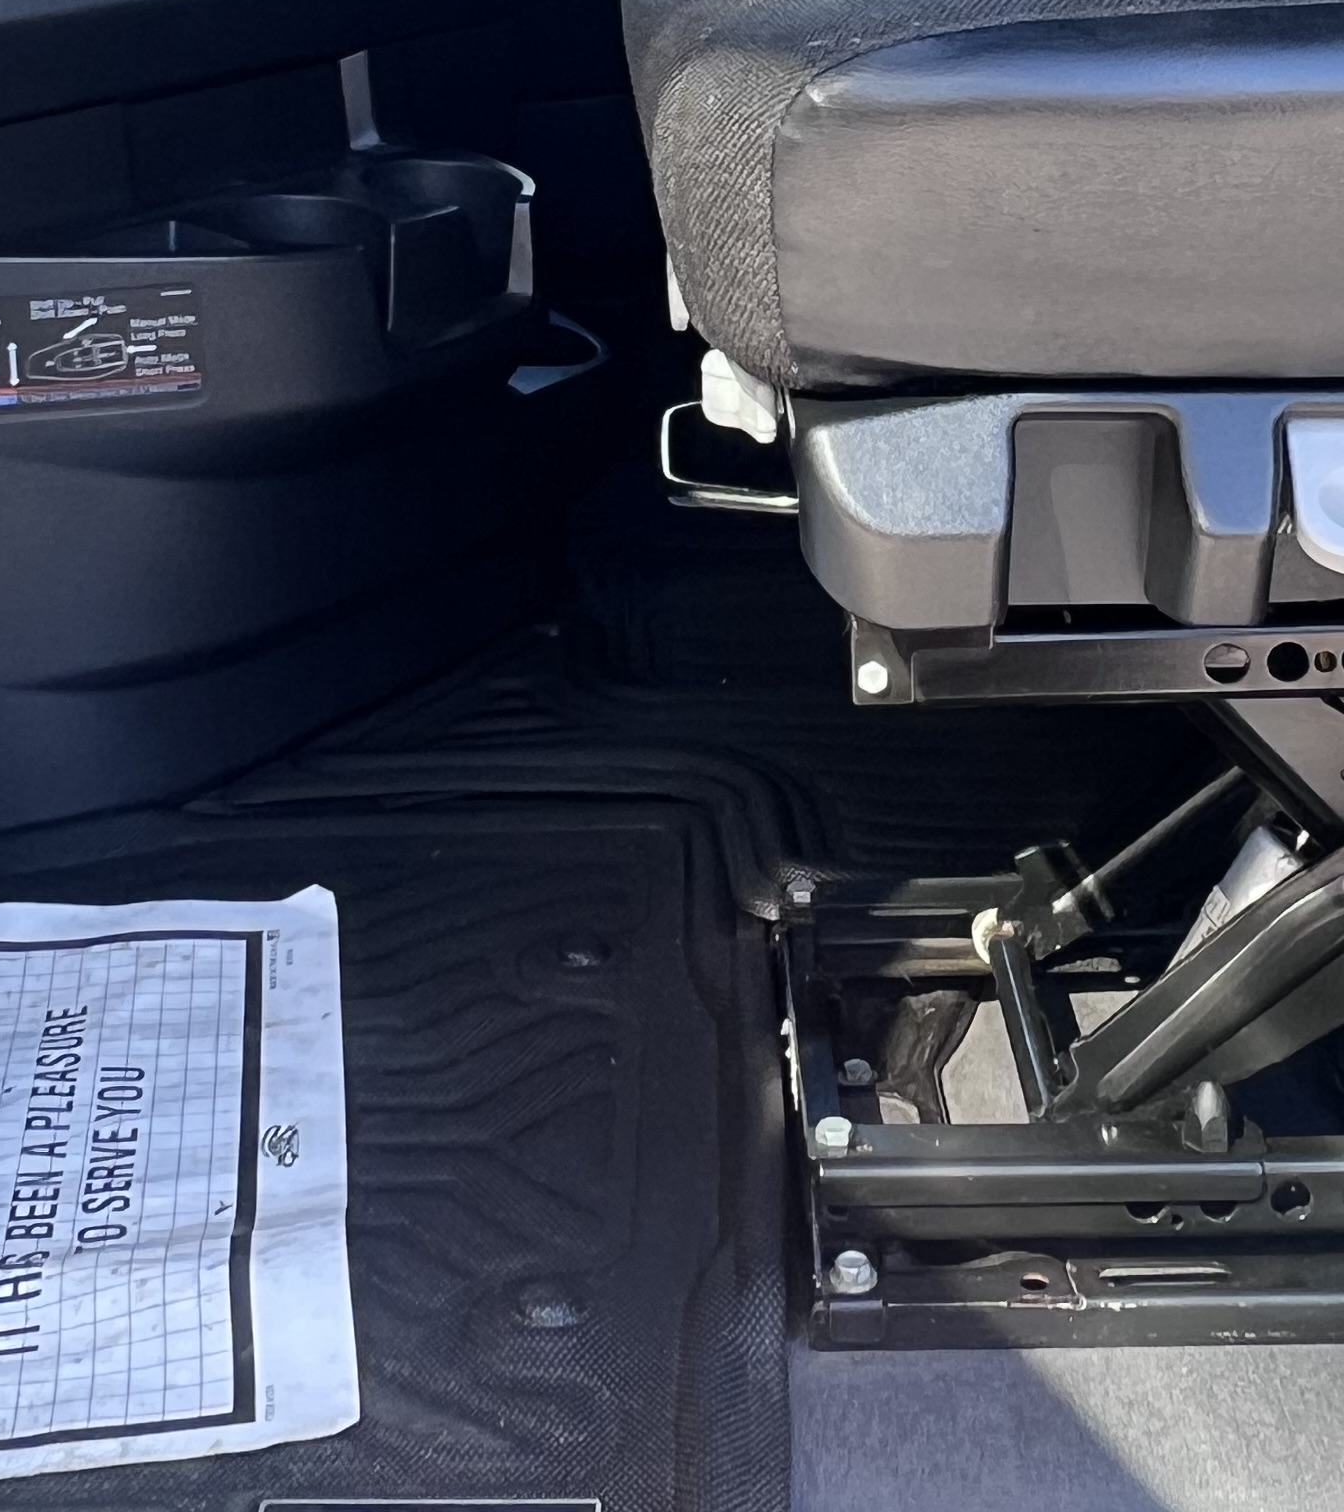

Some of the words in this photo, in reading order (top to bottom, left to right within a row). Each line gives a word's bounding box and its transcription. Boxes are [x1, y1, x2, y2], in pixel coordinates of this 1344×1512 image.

[25, 1005, 88, 1131] PLEASURE
[96, 1066, 146, 1122] YOU
[21, 1141, 68, 1159] A
[81, 1126, 138, 1213] SERVE
[5, 1169, 64, 1241] BEEN
